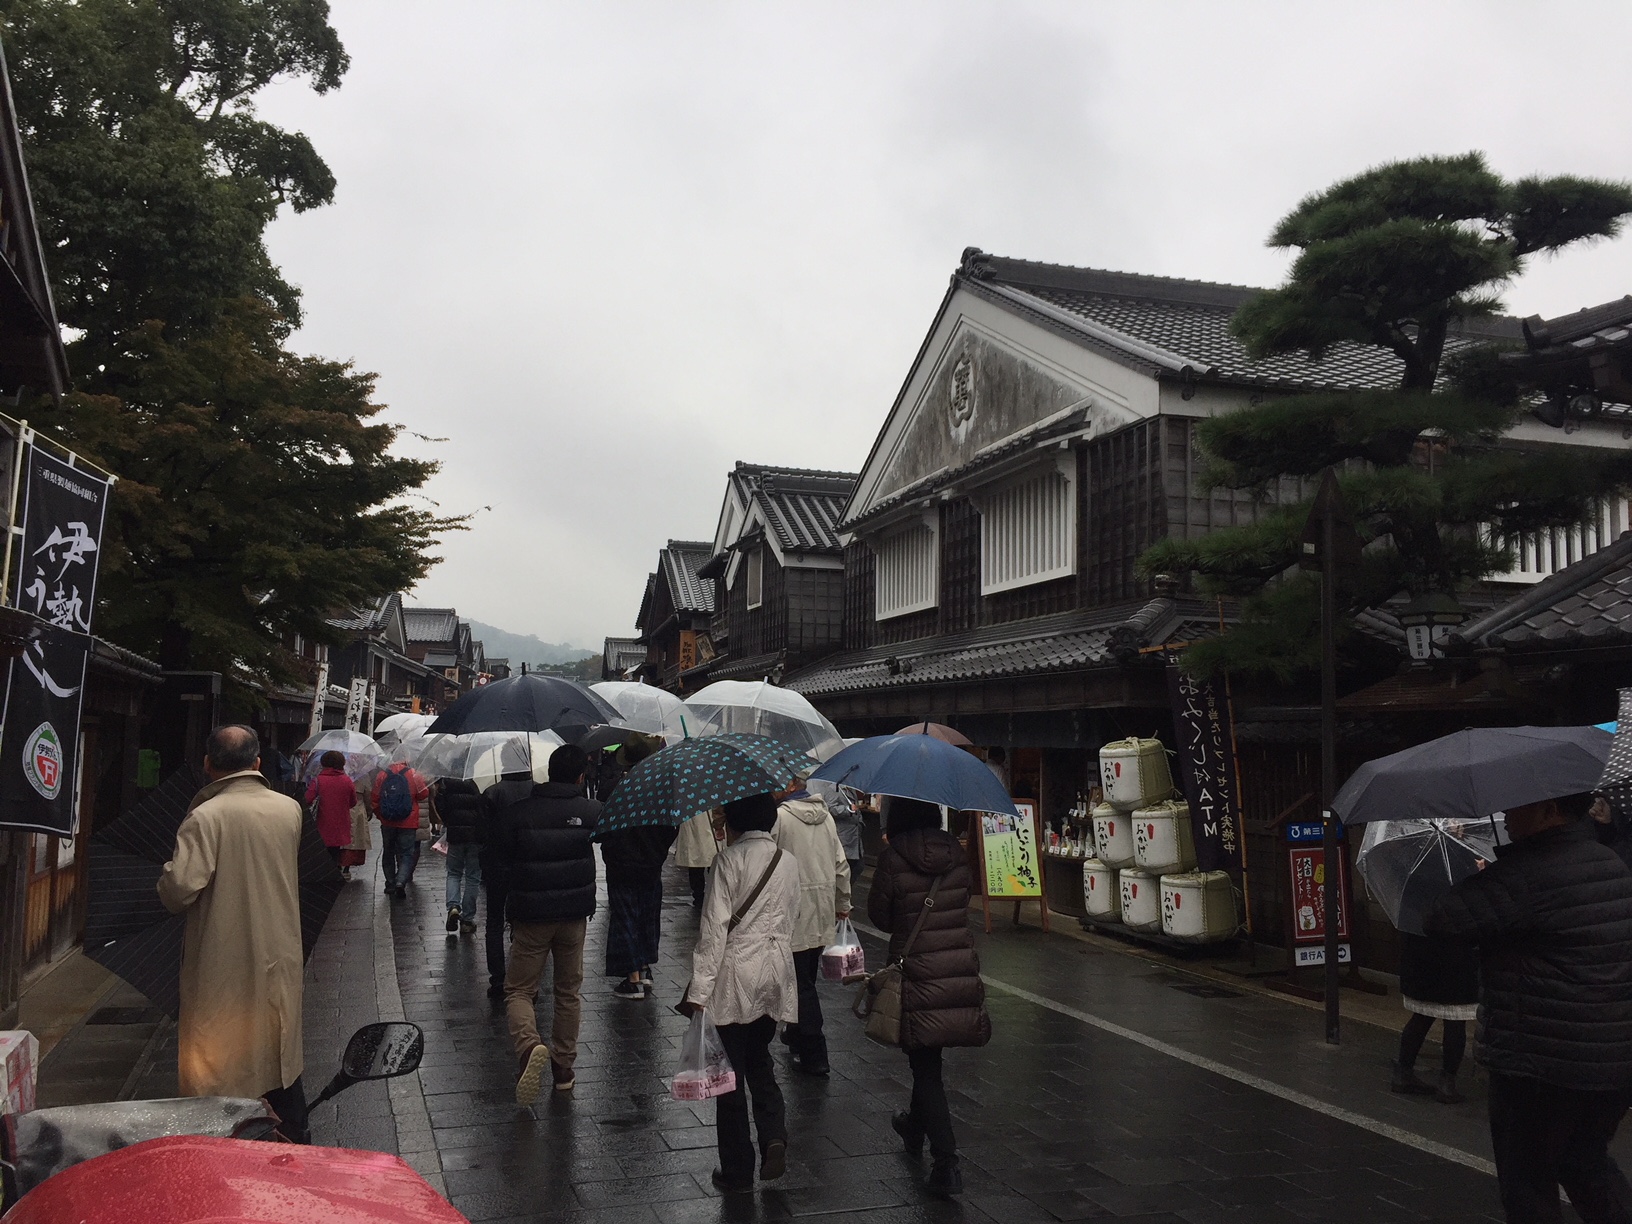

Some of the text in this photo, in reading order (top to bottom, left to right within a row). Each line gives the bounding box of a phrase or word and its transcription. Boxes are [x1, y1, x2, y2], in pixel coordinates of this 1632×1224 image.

[1016, 828, 1038, 888] にごり柚子
